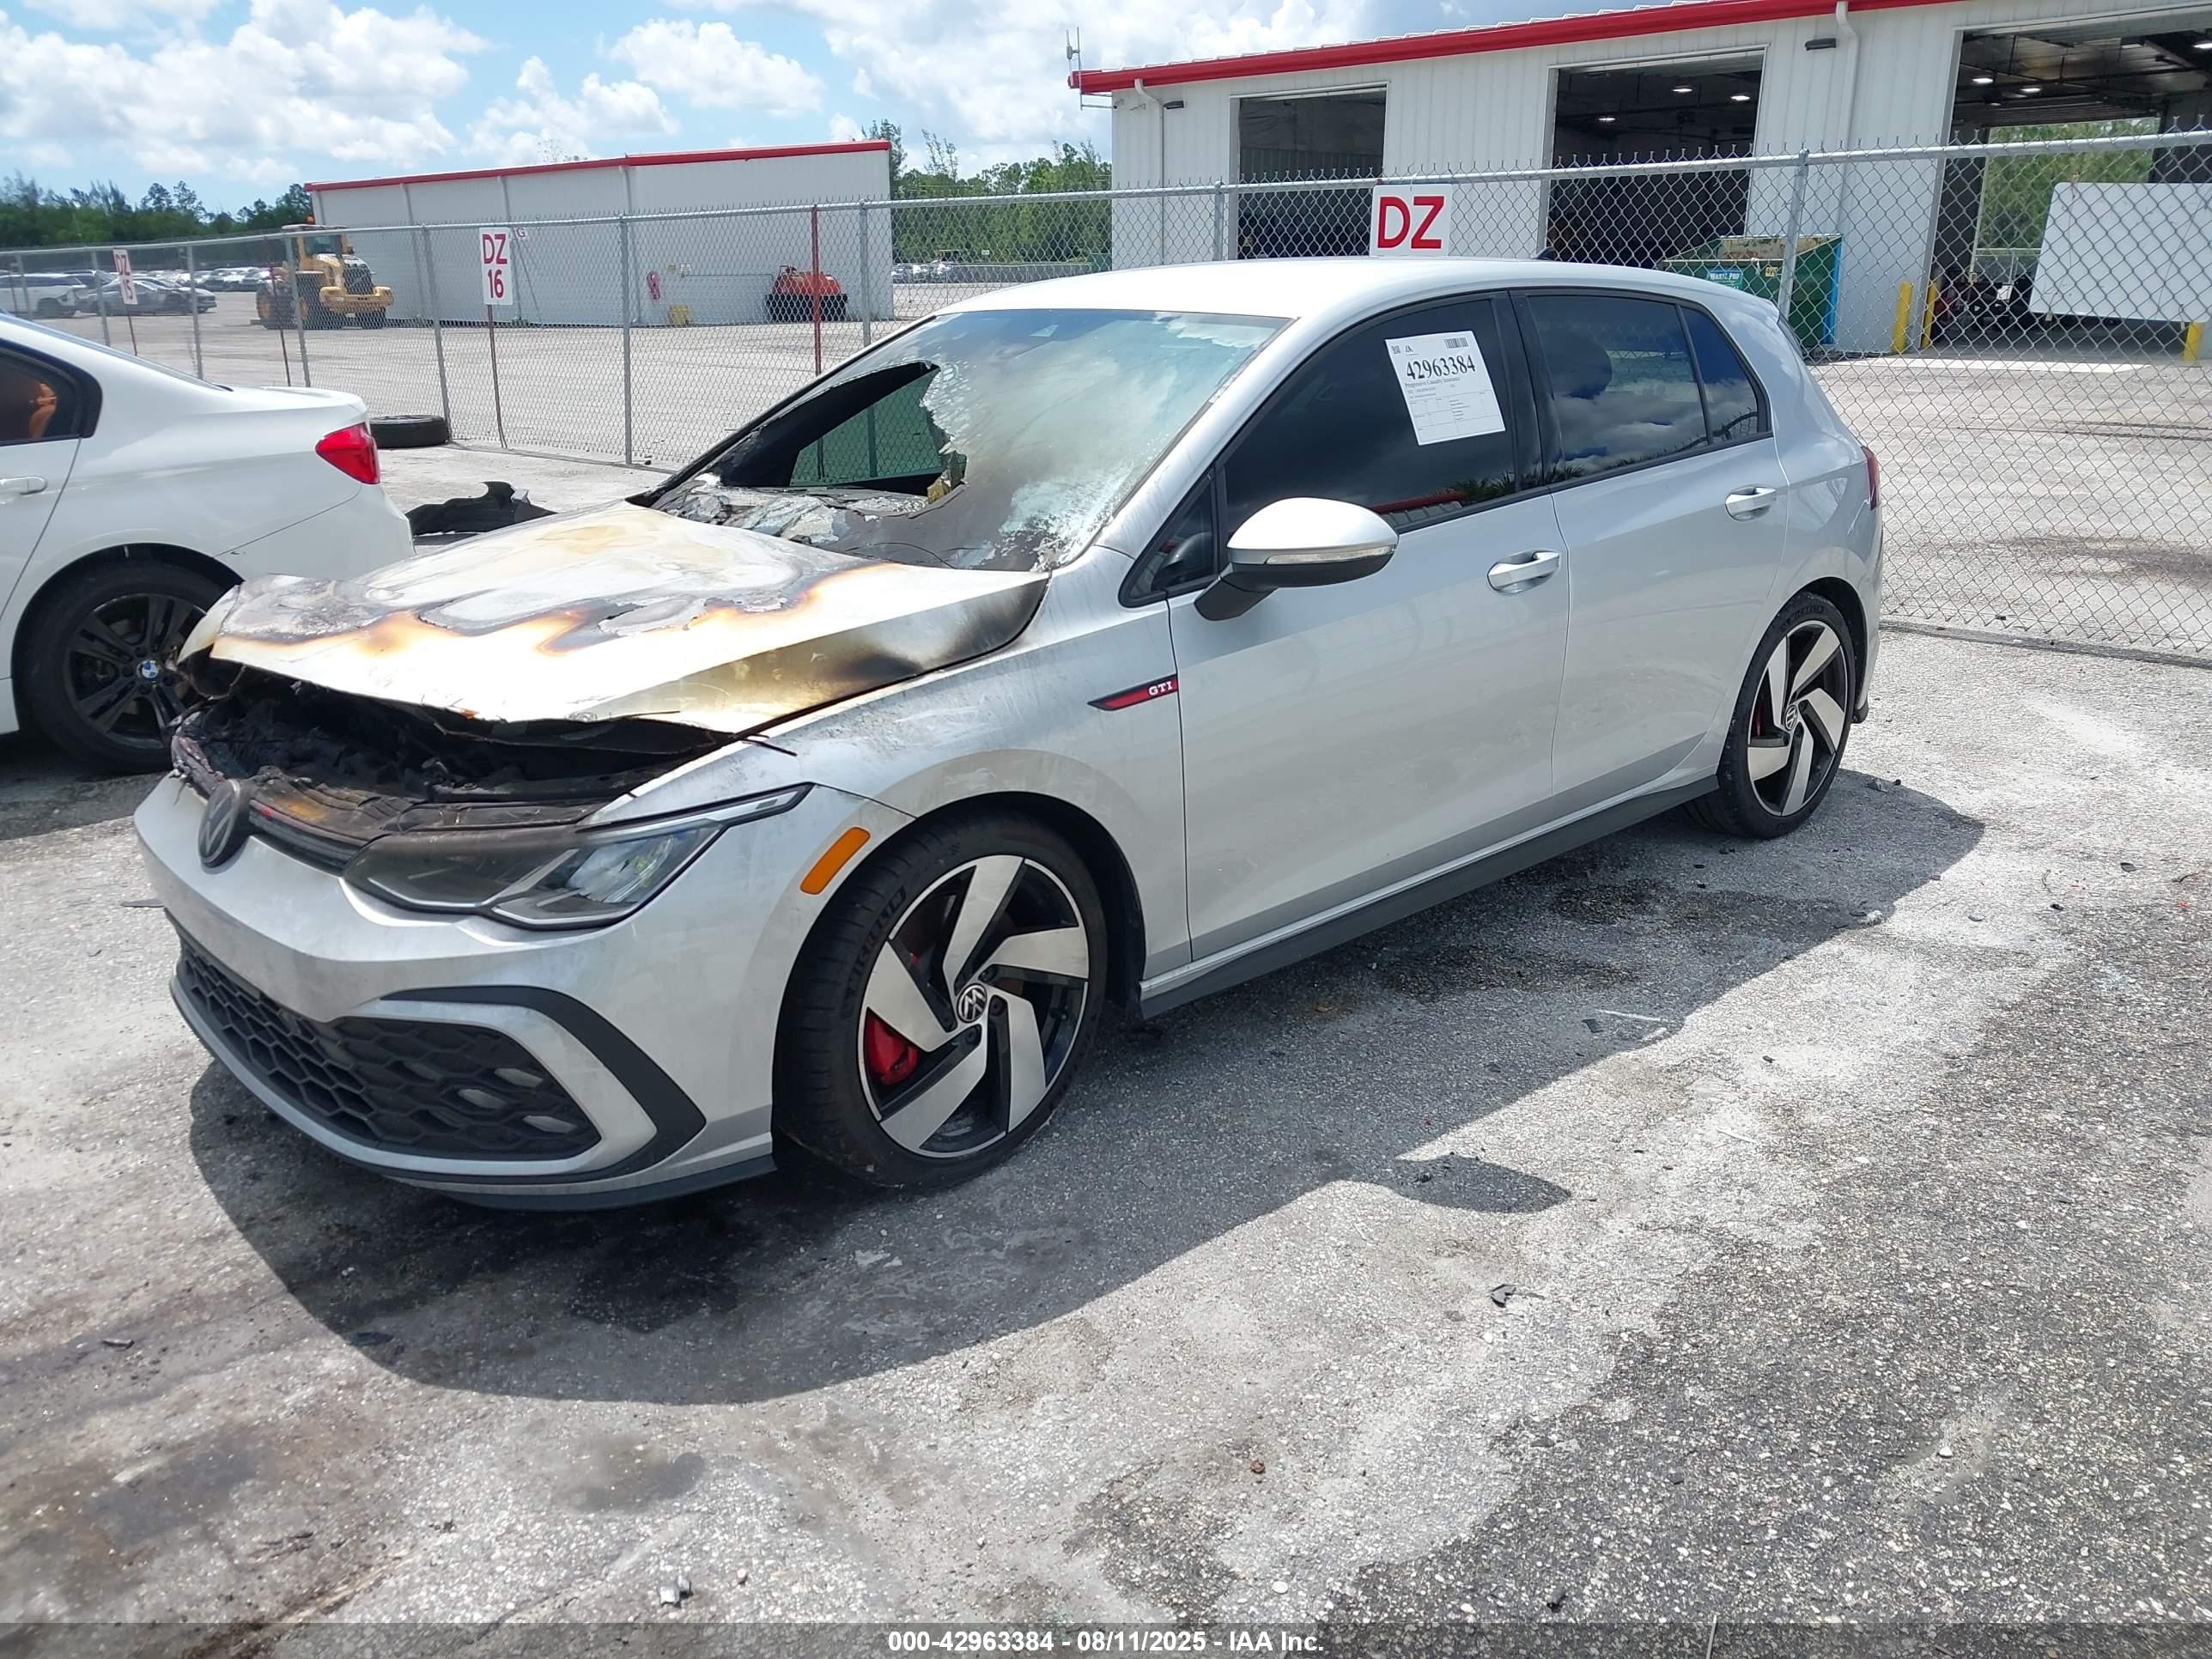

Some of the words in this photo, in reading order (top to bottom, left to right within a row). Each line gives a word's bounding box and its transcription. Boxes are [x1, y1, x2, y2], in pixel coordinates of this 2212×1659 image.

[1376, 195, 1444, 249] DZ
[482, 234, 507, 264] DZ
[115, 253, 131, 276] DZ
[487, 269, 504, 299] 16
[1406, 354, 1475, 380] 42963384
[1148, 681, 1173, 696] GTI
